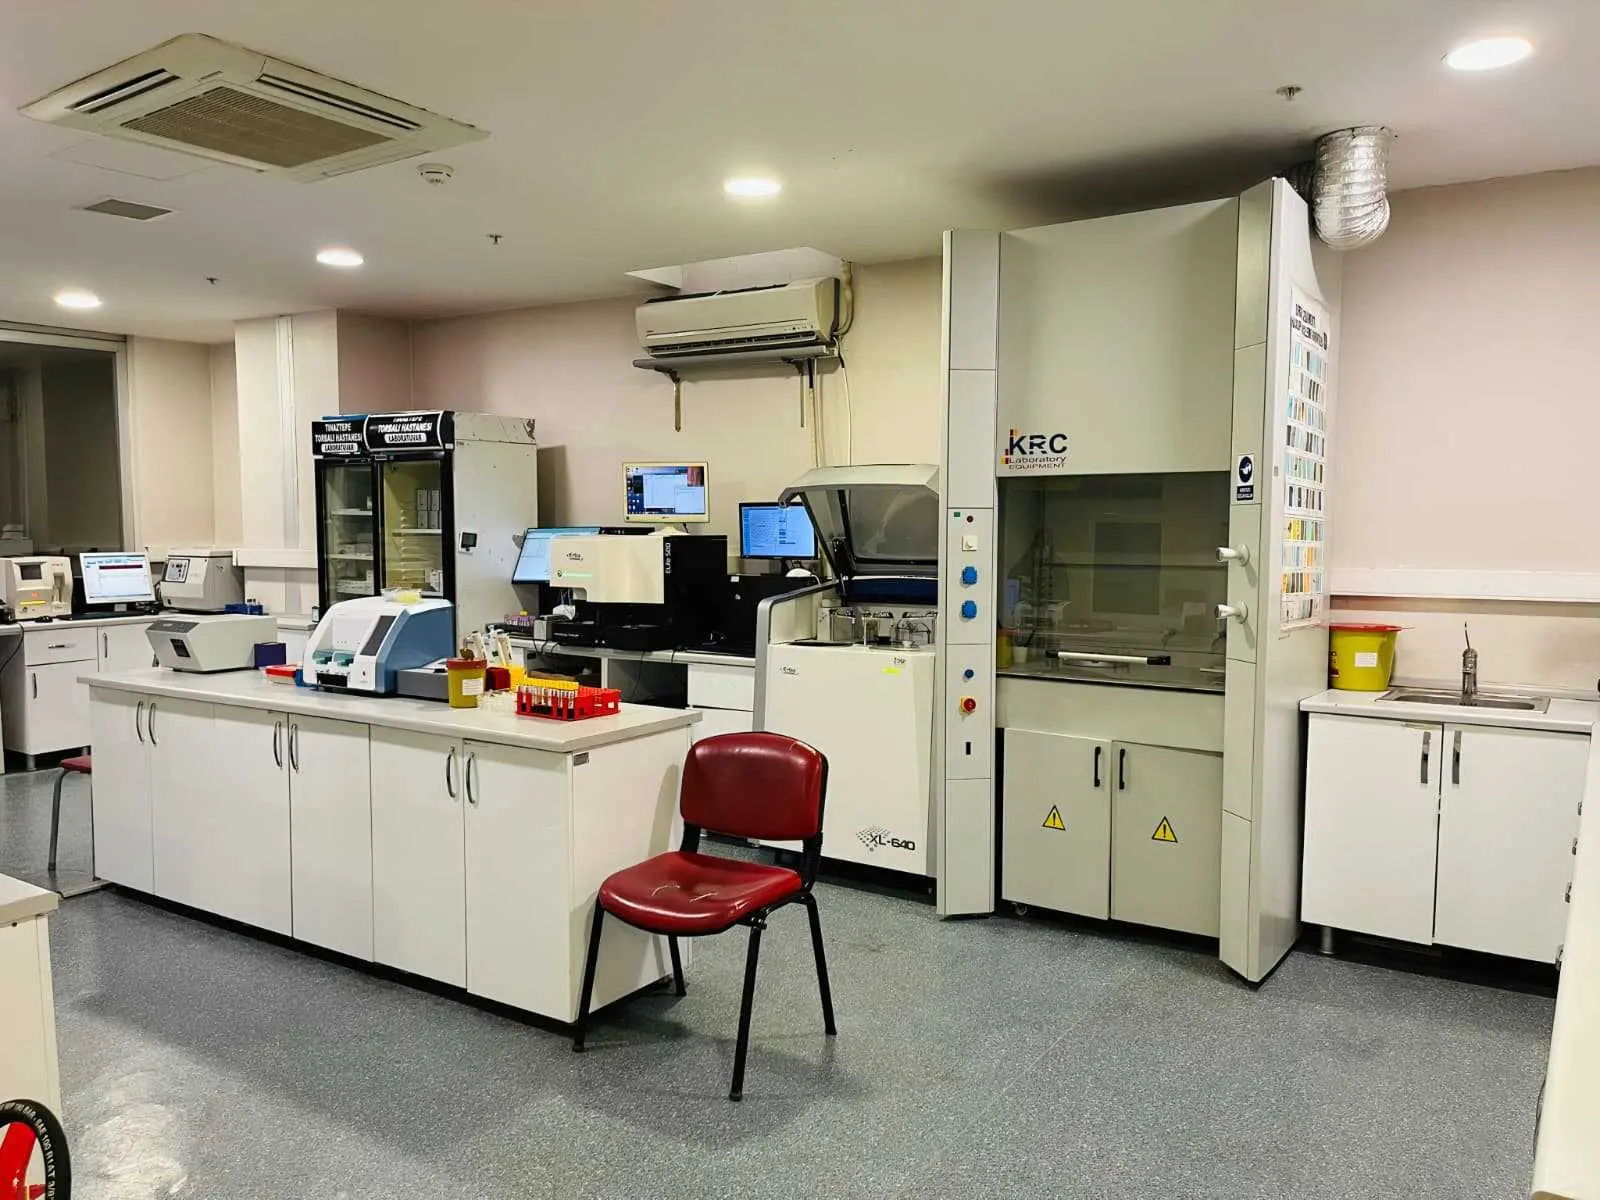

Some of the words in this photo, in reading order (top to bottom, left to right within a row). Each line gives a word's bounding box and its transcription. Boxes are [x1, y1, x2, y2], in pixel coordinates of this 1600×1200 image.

[378, 424, 402, 432] TORBALI
[1009, 433, 1068, 455] KRC
[664, 542, 672, 556] 500
[869, 833, 916, 851] XL-640
